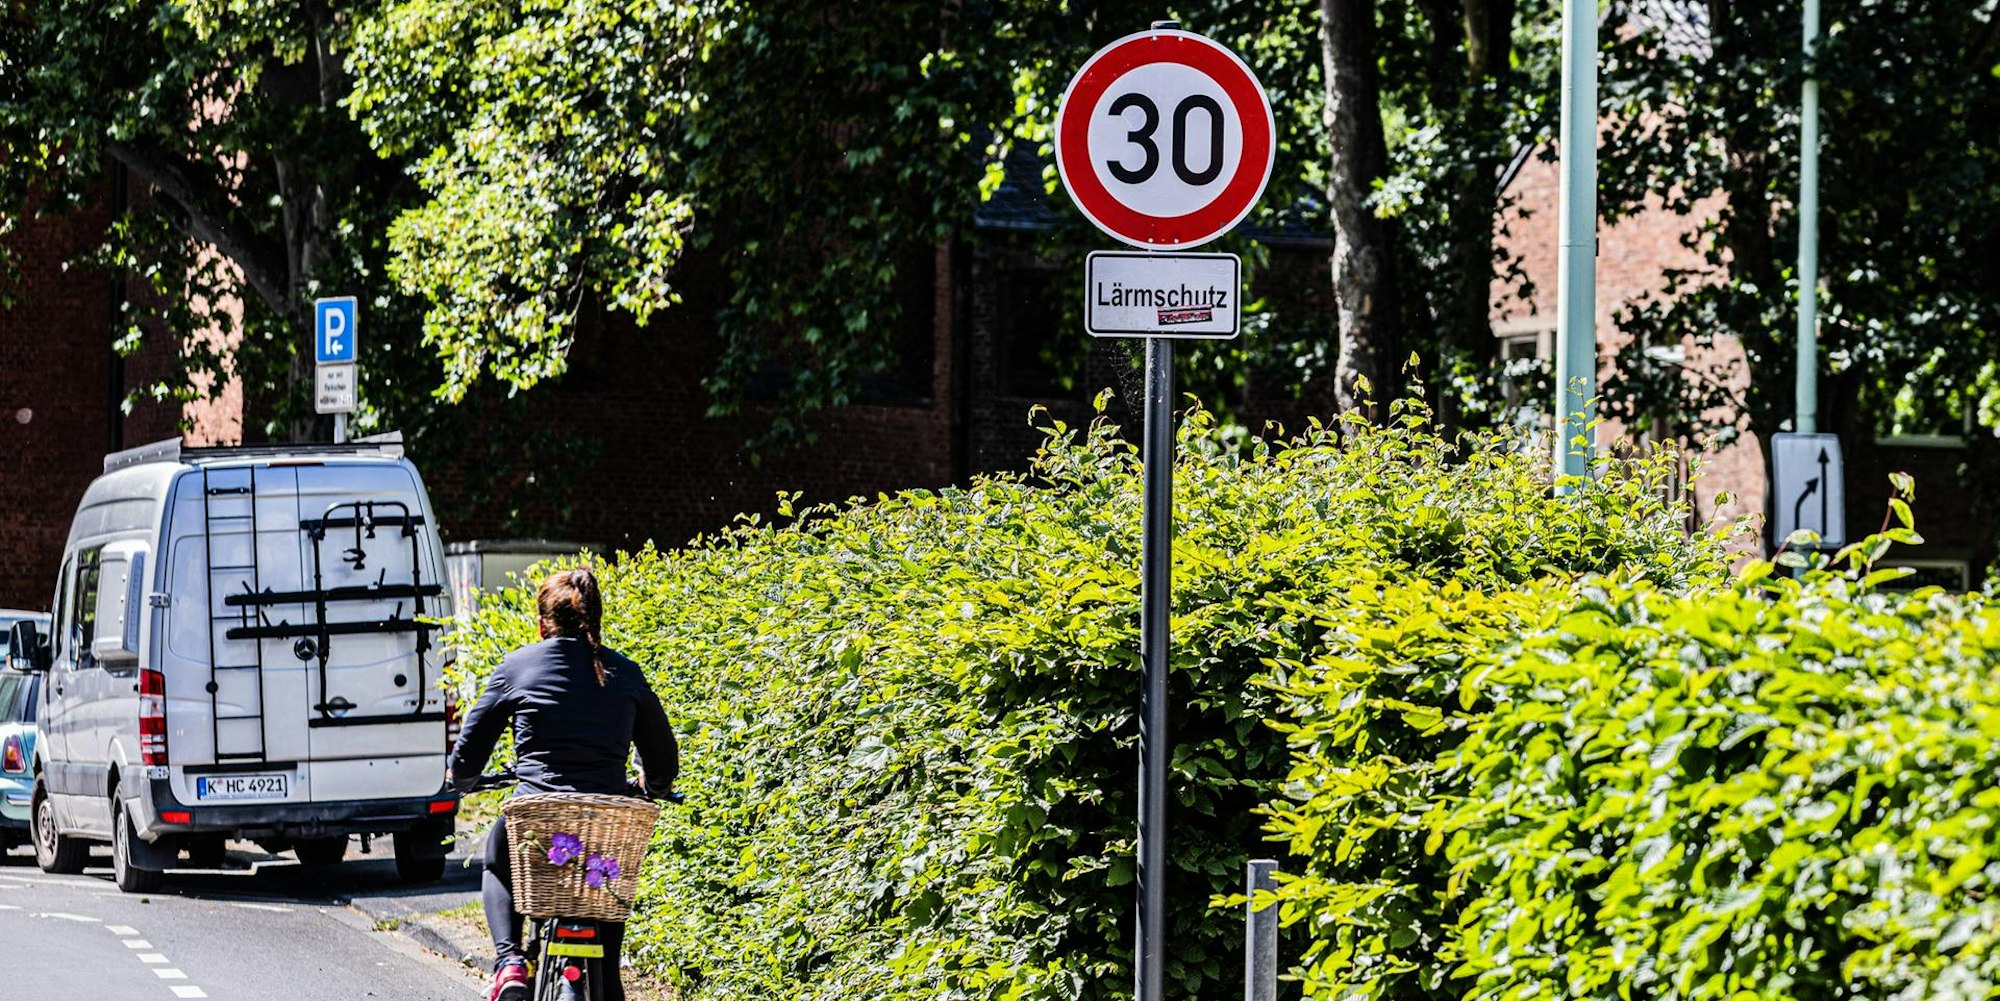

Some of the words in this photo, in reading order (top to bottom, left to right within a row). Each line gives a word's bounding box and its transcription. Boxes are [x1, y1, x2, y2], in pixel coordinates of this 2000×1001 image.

[1106, 92, 1225, 186] 30
[1098, 282, 1228, 309] Lärmschutz
[325, 307, 346, 355] P
[207, 780, 216, 794] K
[226, 779, 245, 793] HC
[248, 778, 284, 792] 4921
